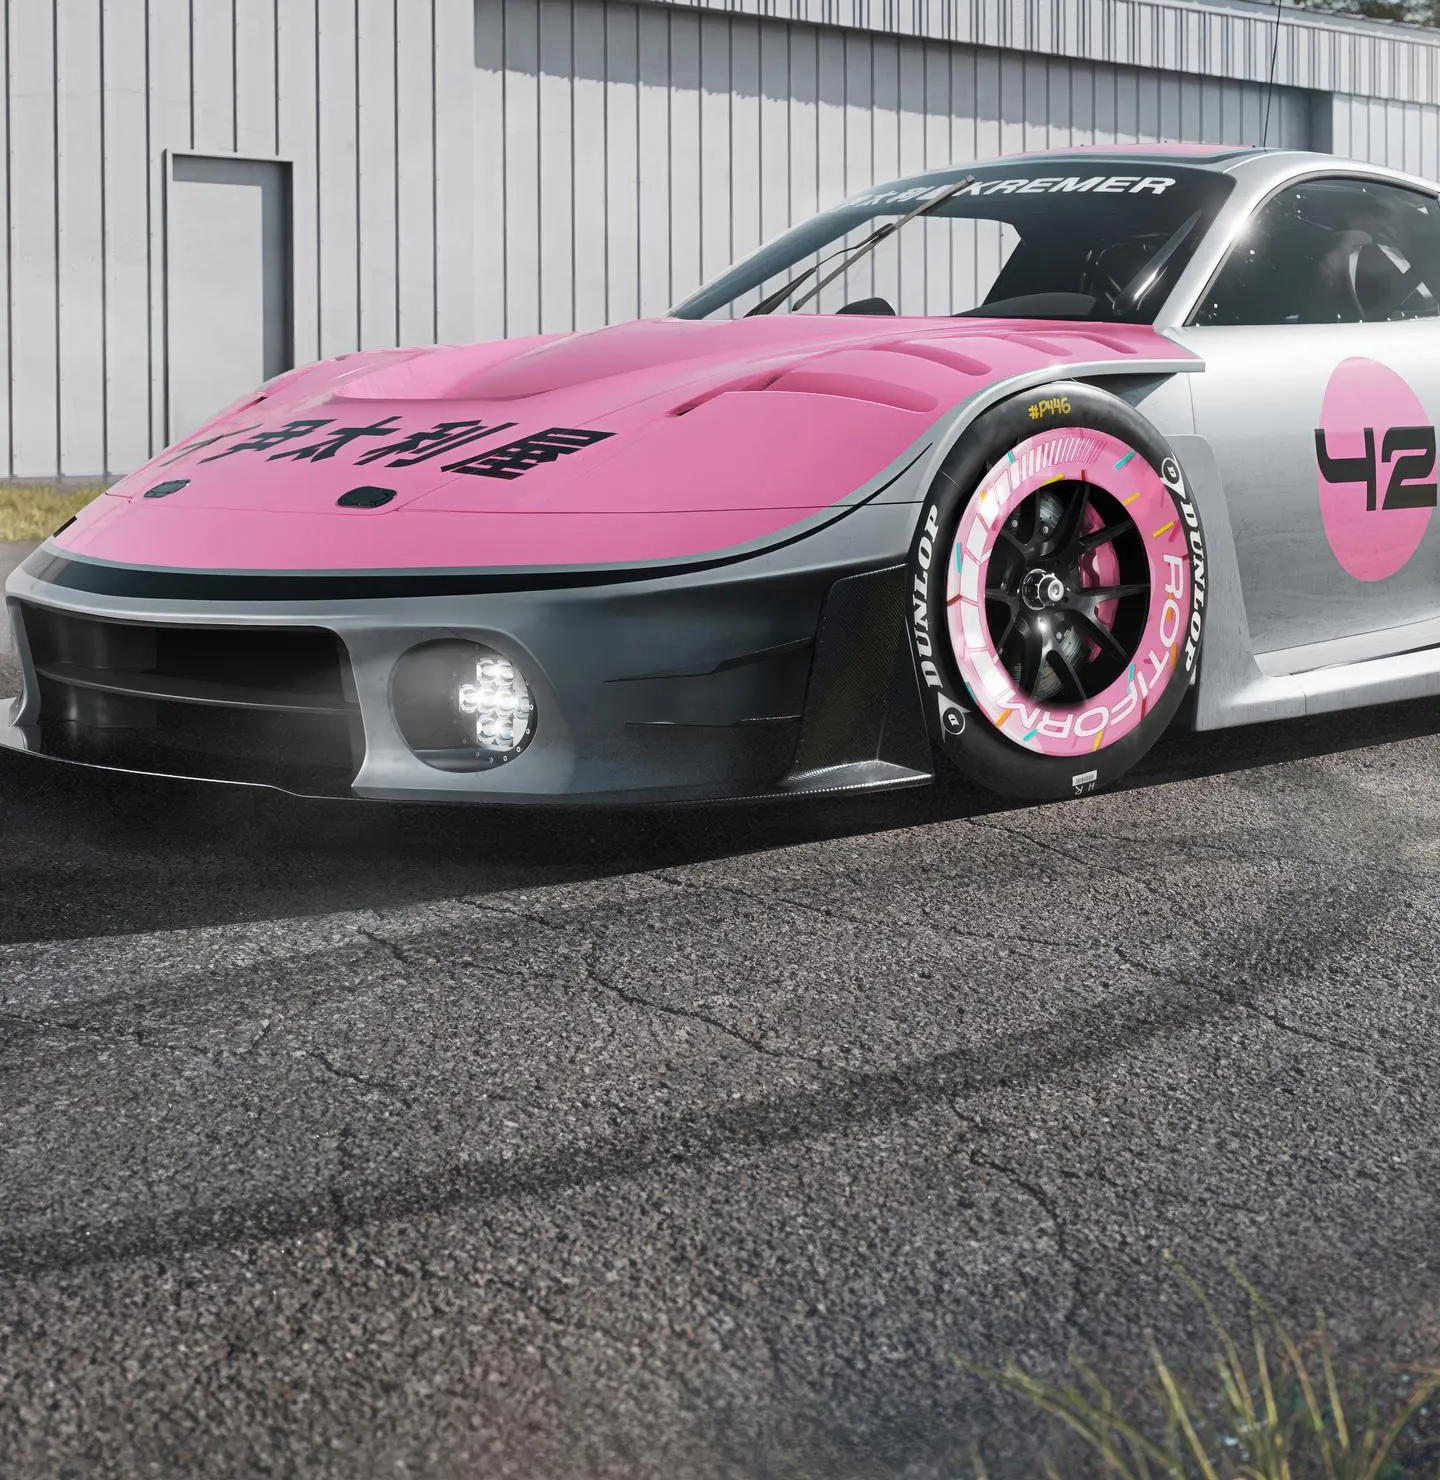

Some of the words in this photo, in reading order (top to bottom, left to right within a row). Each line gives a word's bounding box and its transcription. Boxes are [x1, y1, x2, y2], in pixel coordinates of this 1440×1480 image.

[952, 176, 1176, 196] KREMER
[1028, 397, 1071, 420] #P446
[1314, 425, 1438, 512] 42
[912, 504, 943, 688] DUNLOP
[996, 554, 1183, 739] ROTIFORM
[1181, 501, 1206, 671] DUNLOP
